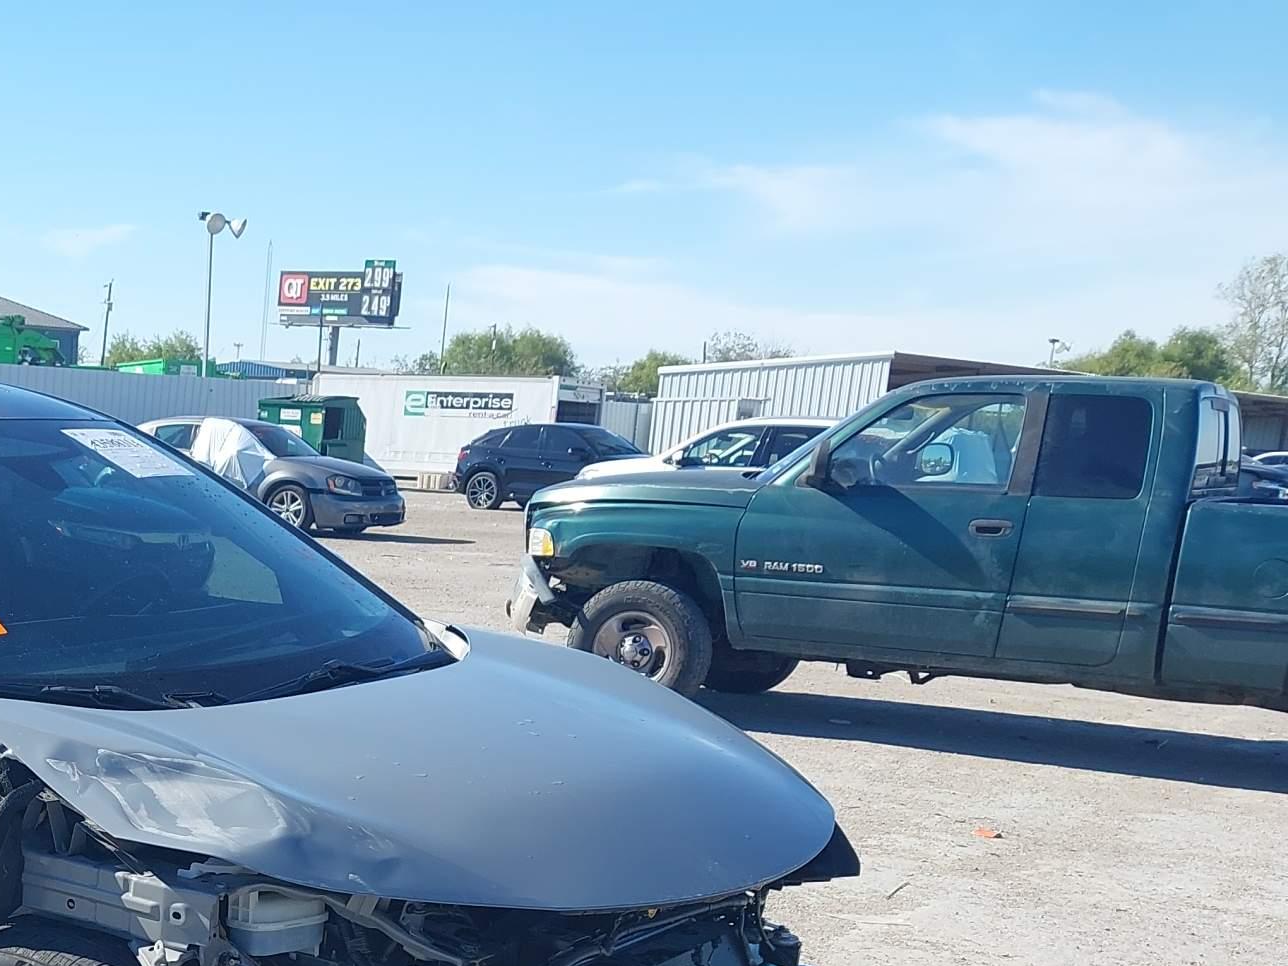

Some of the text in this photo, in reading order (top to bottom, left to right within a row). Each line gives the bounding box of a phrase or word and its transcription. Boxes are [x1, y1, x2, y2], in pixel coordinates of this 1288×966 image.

[283, 278, 305, 299] QT
[310, 277, 362, 291] EXIT 273
[427, 393, 512, 409] Enterprise
[763, 560, 790, 571] RAM
[791, 563, 824, 574] 1500
